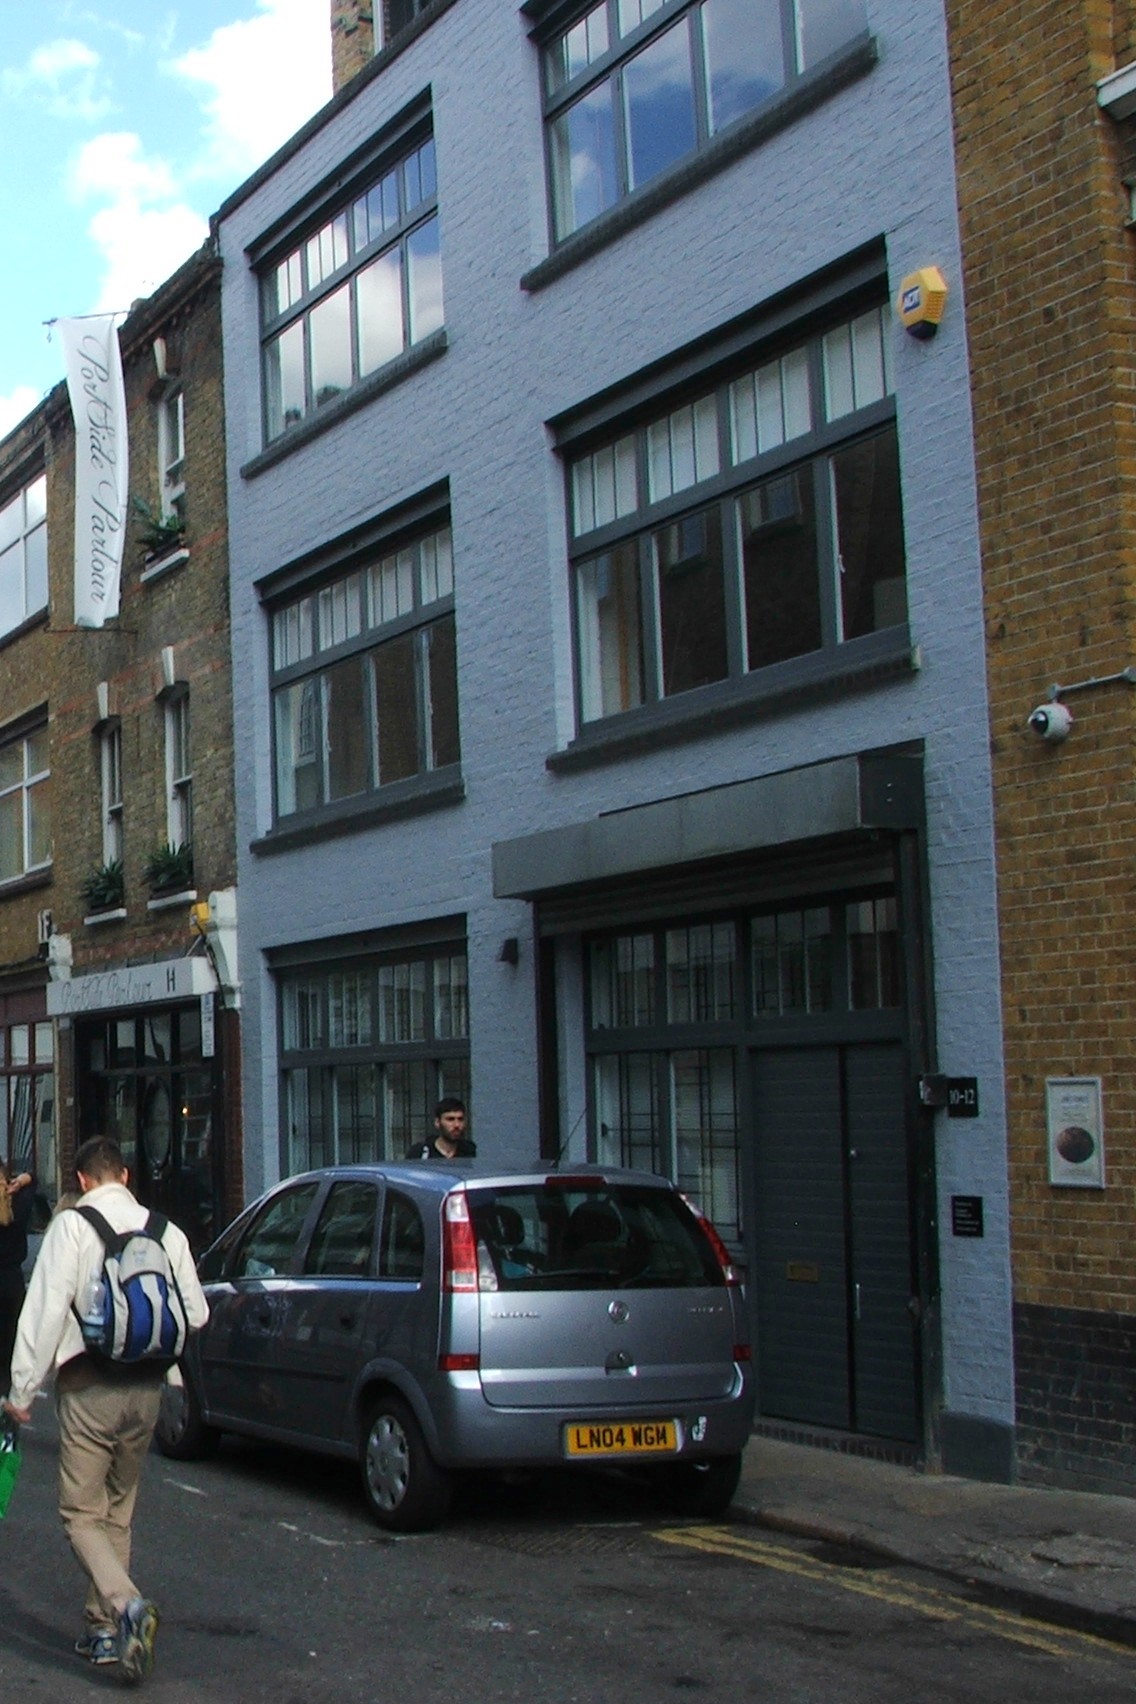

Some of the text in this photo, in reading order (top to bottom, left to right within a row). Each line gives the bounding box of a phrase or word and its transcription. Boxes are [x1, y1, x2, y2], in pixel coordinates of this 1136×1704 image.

[90, 480, 121, 603] Parlour
[949, 1089, 975, 1105] 10-12
[576, 1427, 626, 1449] LN04
